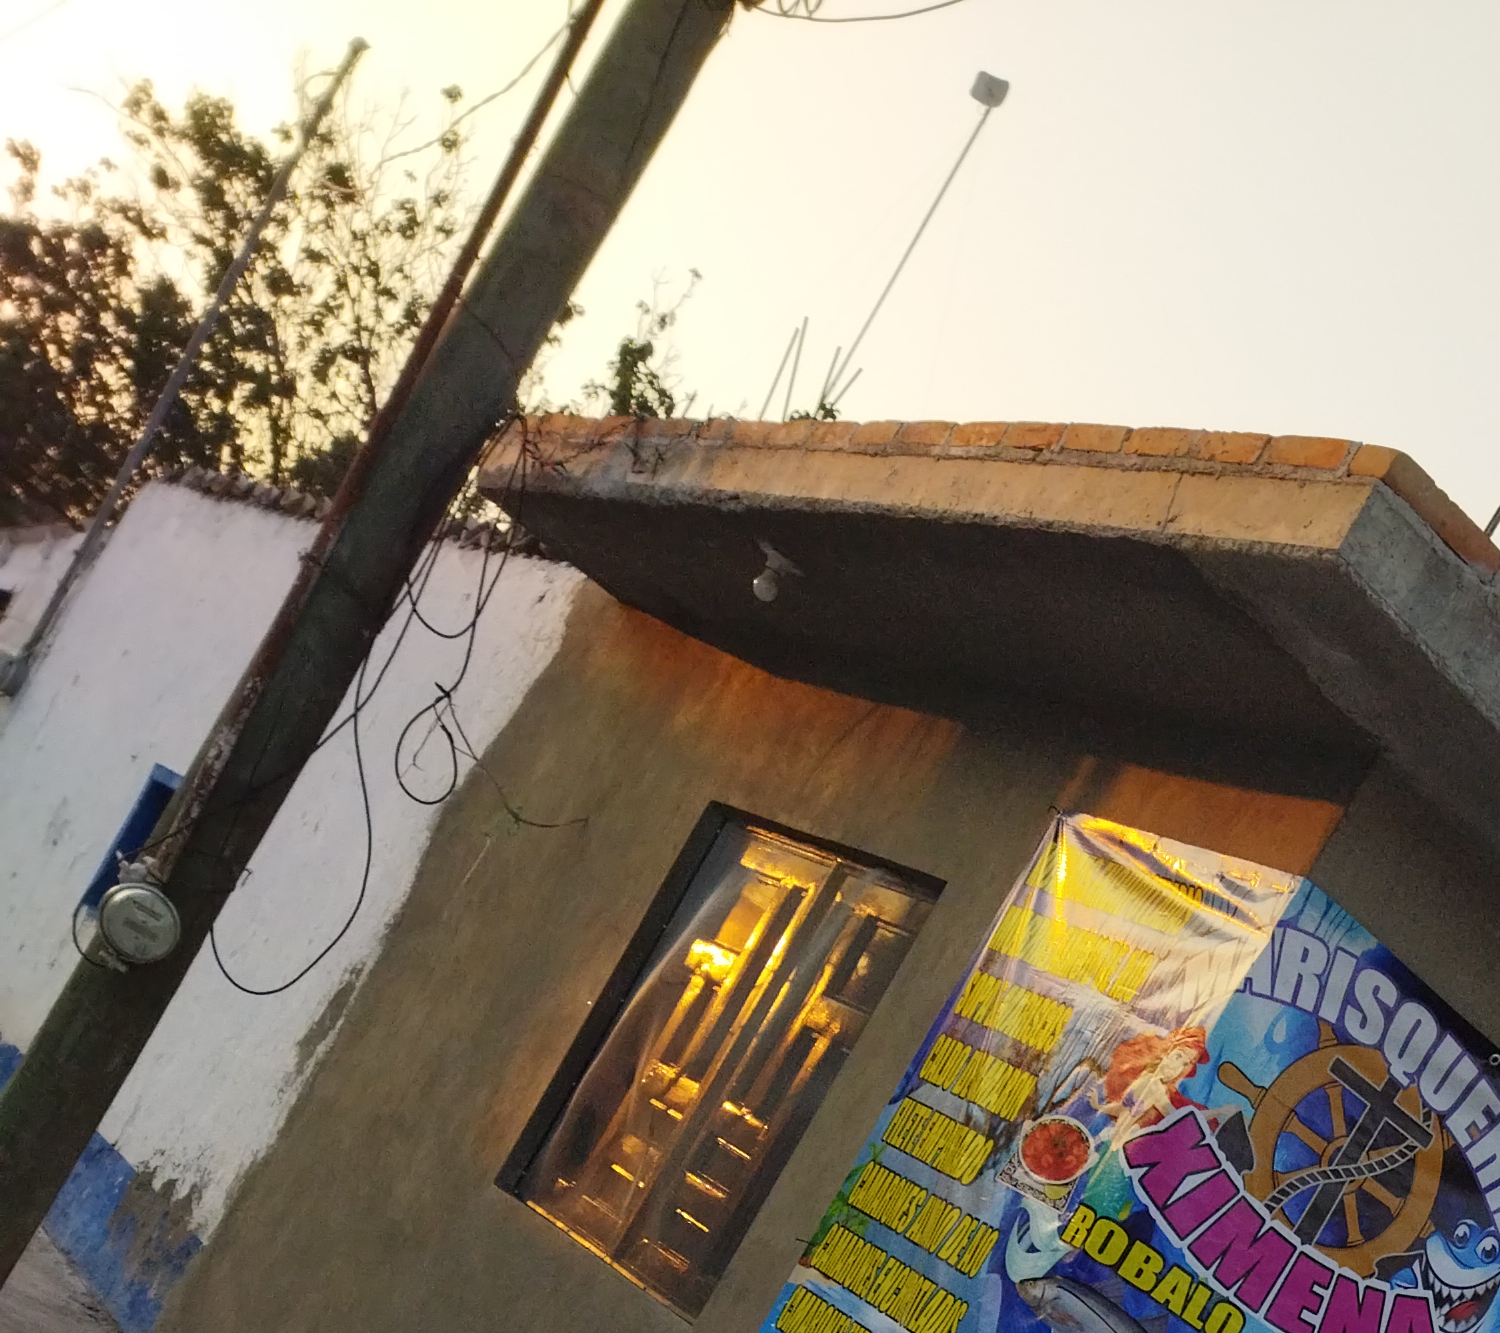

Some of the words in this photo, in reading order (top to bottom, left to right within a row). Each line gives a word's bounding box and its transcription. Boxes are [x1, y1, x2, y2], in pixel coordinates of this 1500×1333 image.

[951, 969, 1006, 1025] SOPA
[916, 1032, 974, 1091] CALDO
[880, 1096, 934, 1154] FILETE
[844, 1158, 929, 1236] CAMARONES
[807, 1220, 889, 1300] CAMARONES
[935, 1210, 982, 1267] DE
[954, 1221, 1002, 1279] AJO
